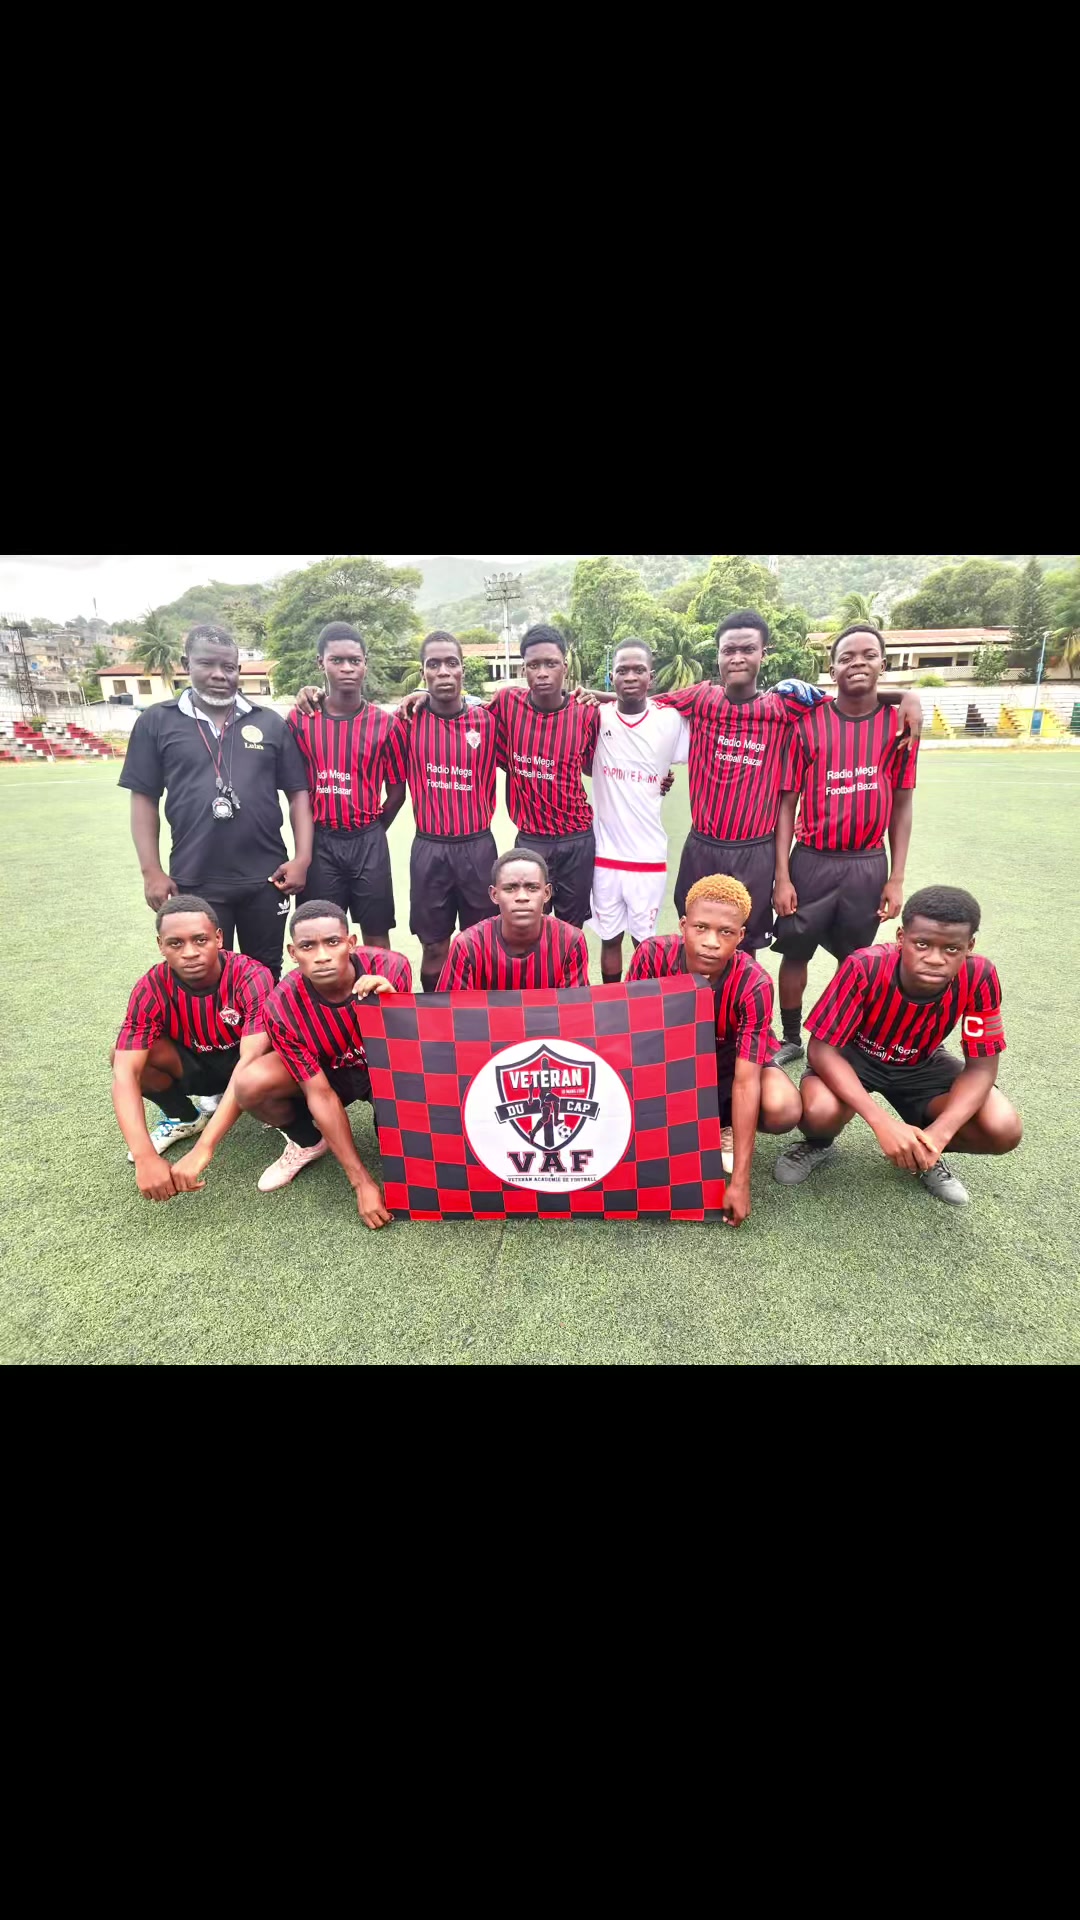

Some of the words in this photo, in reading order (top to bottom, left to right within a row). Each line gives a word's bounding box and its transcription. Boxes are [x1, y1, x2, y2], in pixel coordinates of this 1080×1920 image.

[718, 735, 741, 748] Radio
[743, 739, 766, 752] Mega
[513, 752, 532, 764] Radio
[533, 756, 555, 768] Mega
[715, 751, 742, 763] Football
[743, 755, 763, 766] Bazar
[329, 769, 351, 782] Mega
[426, 763, 450, 774] Radio
[451, 766, 473, 778] Mega
[537, 771, 556, 780] Bazar
[827, 768, 853, 780] Radio
[855, 766, 878, 777] Mega
[333, 785, 352, 795] Bazar
[427, 779, 452, 790] Football
[454, 782, 473, 791] Bazar
[964, 1016, 984, 1037] C
[509, 1068, 582, 1089] VETERAN
[506, 1103, 525, 1117] DU
[566, 1101, 591, 1113] CAP
[507, 1150, 594, 1174] VAF
